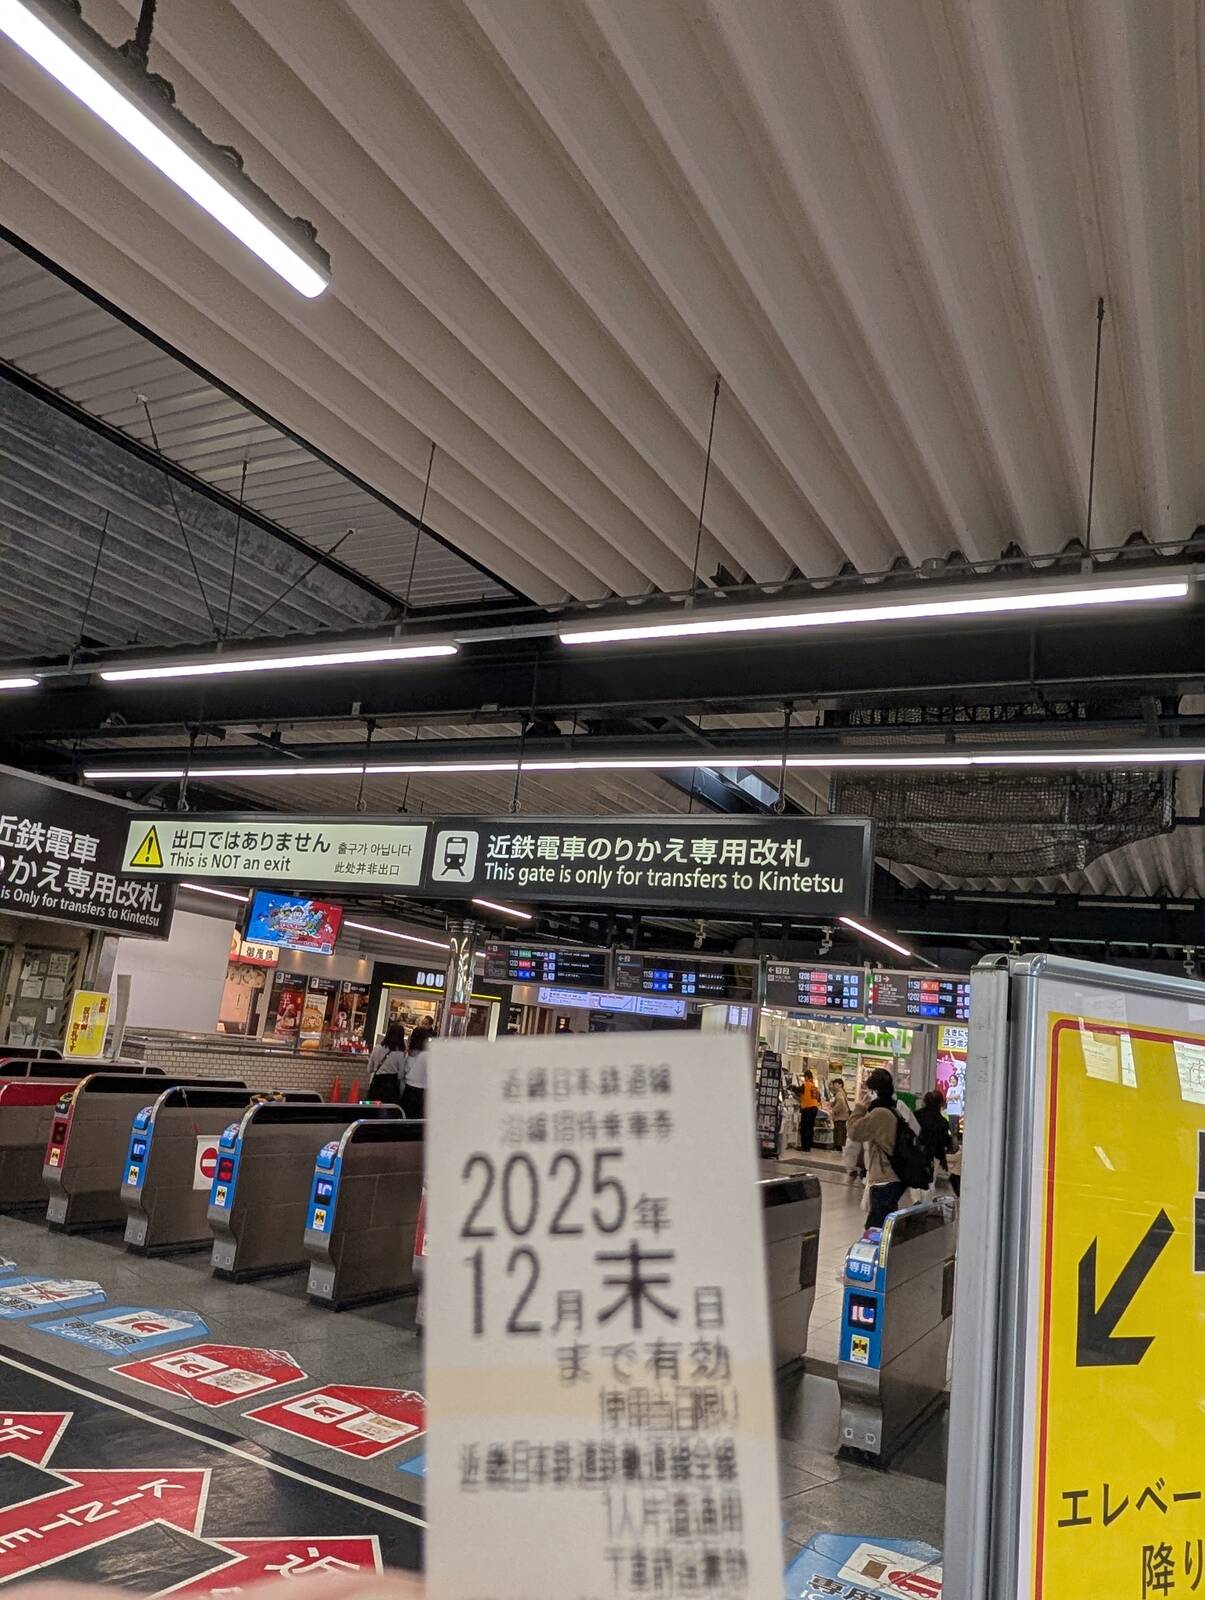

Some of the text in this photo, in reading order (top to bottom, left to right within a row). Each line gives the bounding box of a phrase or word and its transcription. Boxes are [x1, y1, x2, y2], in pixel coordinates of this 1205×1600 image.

[172, 829, 331, 854] 出口ではありません
[337, 843, 412, 857] 출구가 아닙니다
[486, 834, 811, 868] 近鉄電車のりかえ専用改札
[170, 852, 291, 872] This is NOT an exit
[334, 862, 400, 876] 此处并非出口
[484, 862, 844, 894] This gate is only for transfers to Kintetsu
[1, 885, 160, 927] is Only for transfers to Kintetsu
[853, 1023, 913, 1049] Famil
[460, 1147, 671, 1238] 2025年
[848, 1261, 872, 1276] 専用
[463, 1239, 724, 1336] 12月末日
[556, 1337, 731, 1384] まで有効
[0, 1478, 186, 1554] KINTE
[1058, 1477, 1202, 1528] エレベー
[1142, 1539, 1203, 1600] 降り
